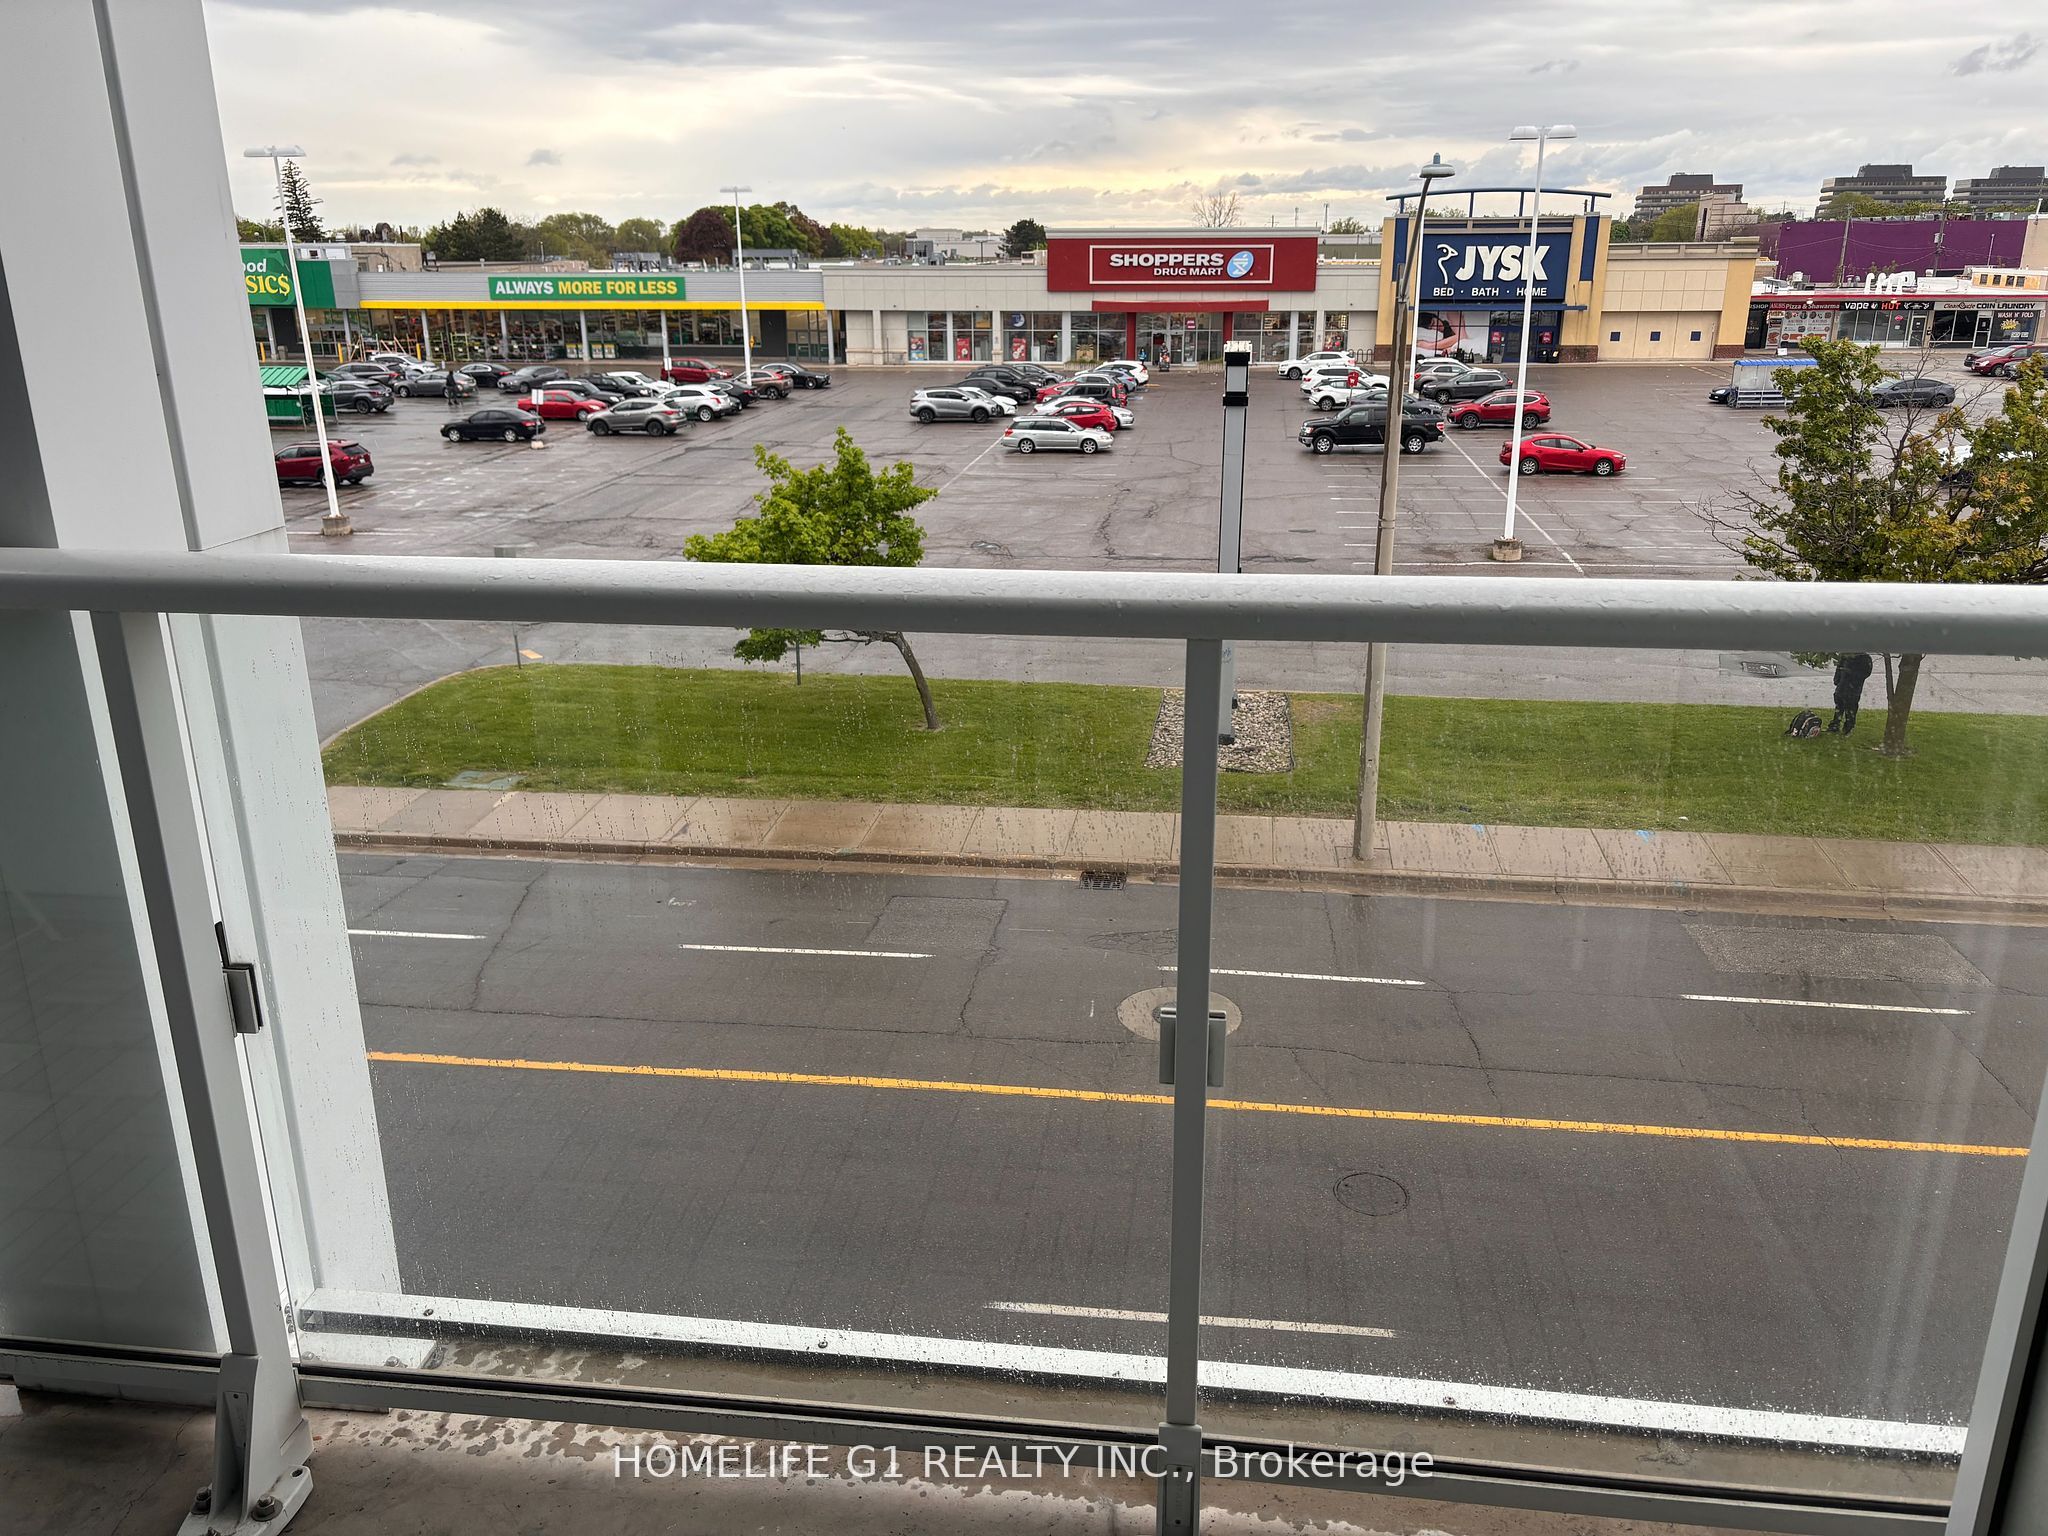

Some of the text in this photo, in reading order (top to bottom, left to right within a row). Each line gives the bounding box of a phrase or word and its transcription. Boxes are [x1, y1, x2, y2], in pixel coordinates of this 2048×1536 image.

[1109, 253, 1224, 267] SHOPPERS
[1455, 245, 1550, 281] JYSK
[1153, 267, 1223, 276] DRUG MART
[495, 281, 677, 295] ALWAYS MORE FOR LESS
[1433, 287, 1454, 297] BED
[1471, 287, 1499, 297] BATH
[1845, 302, 1901, 311] vape HUT
